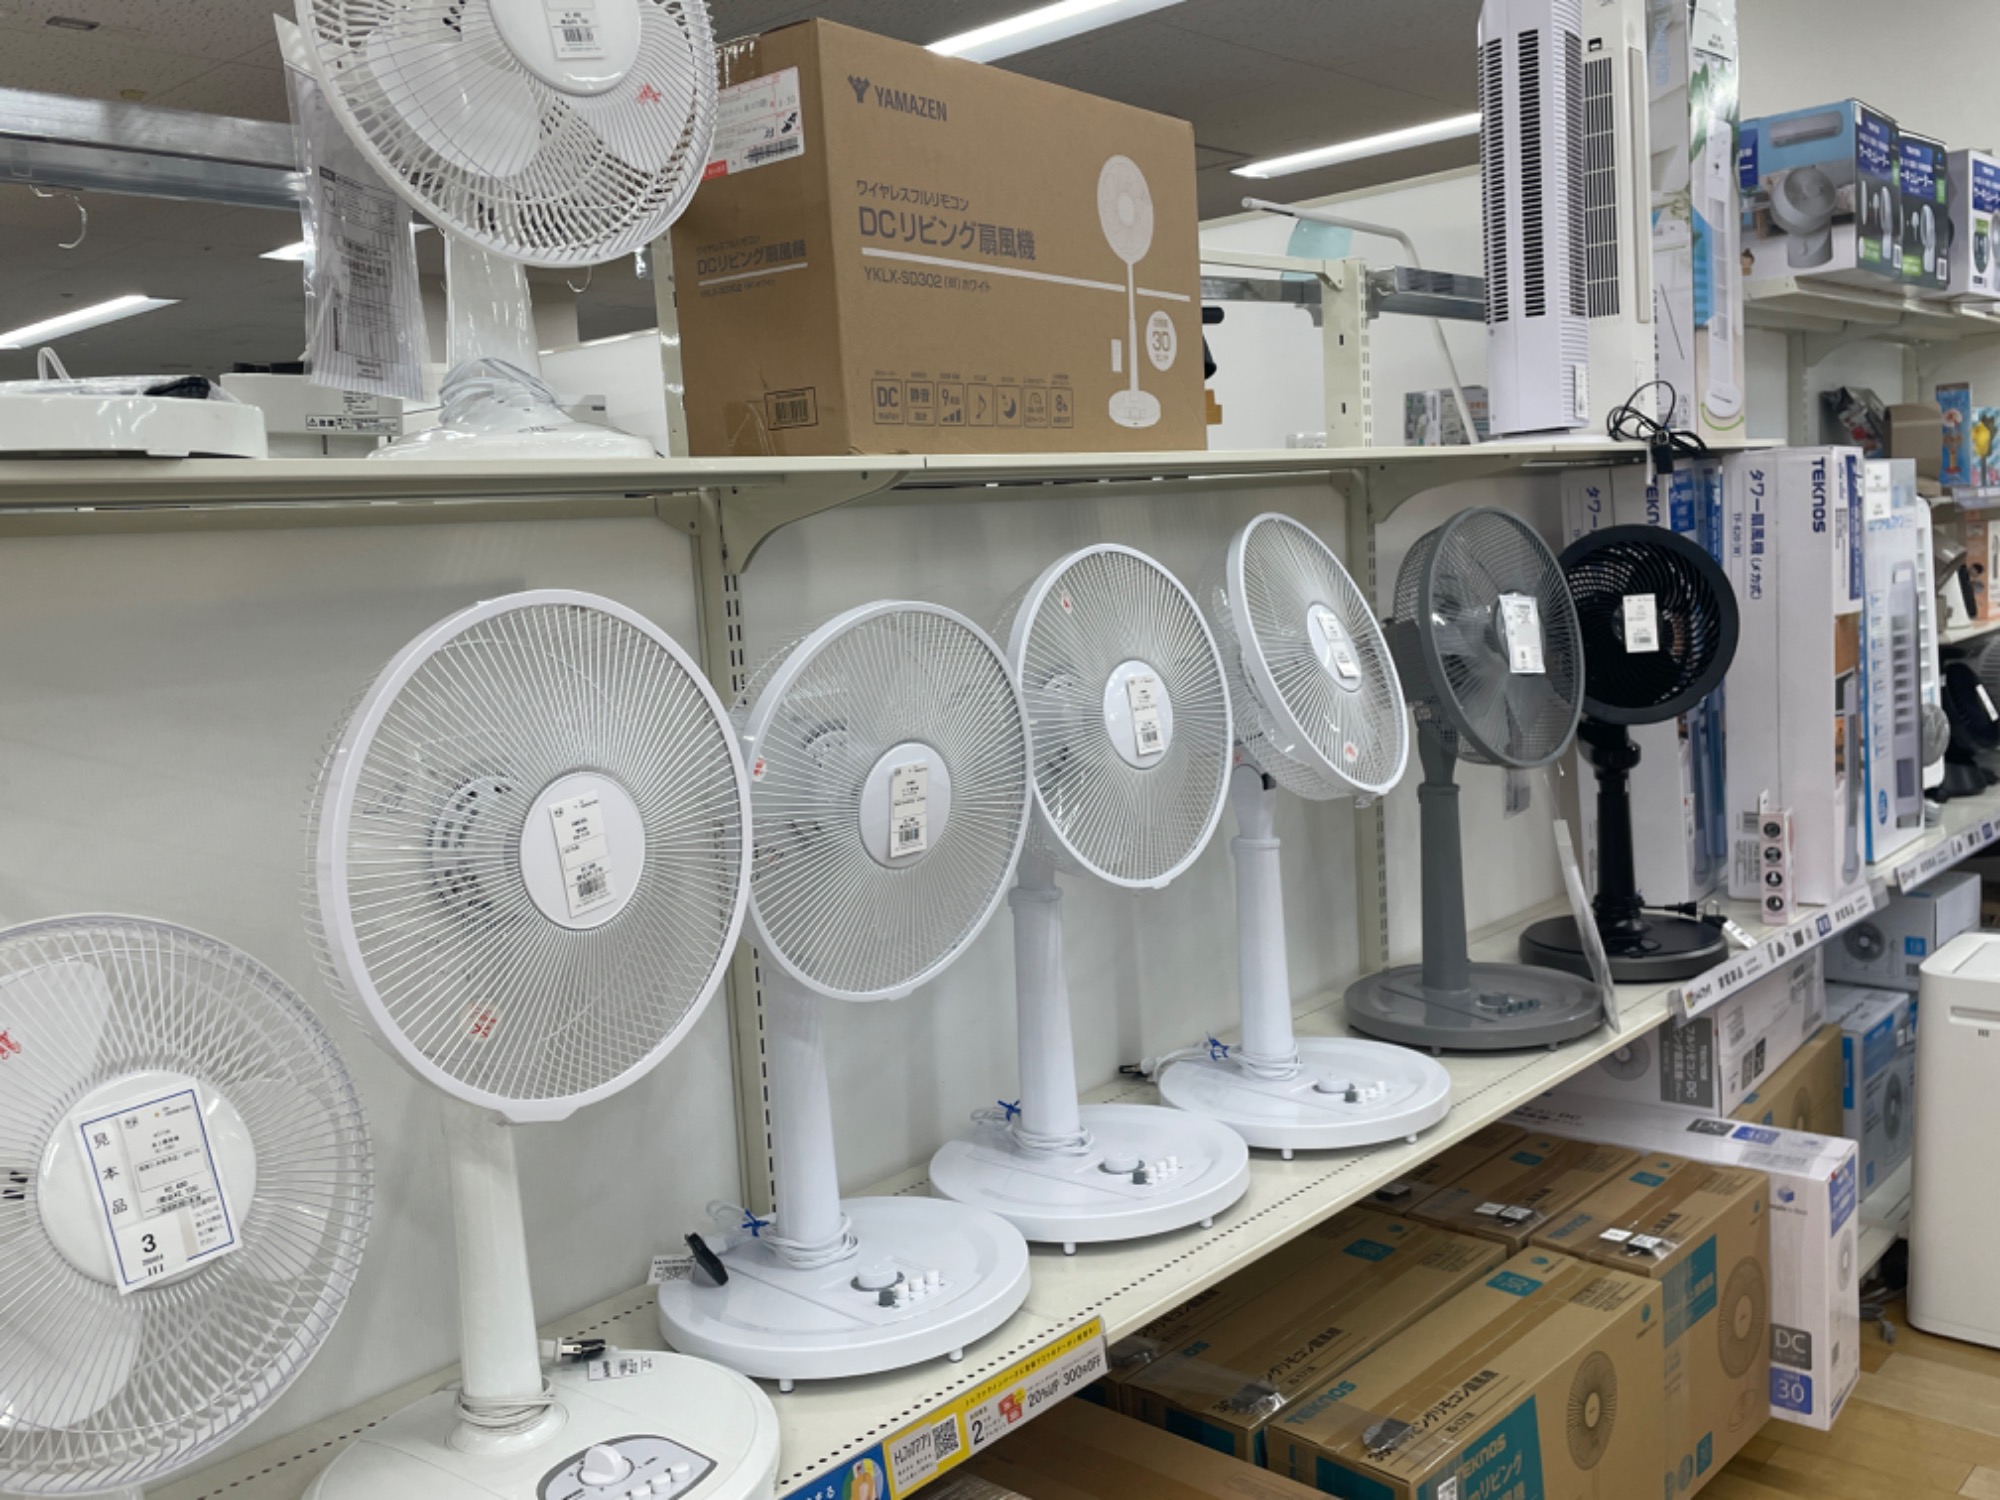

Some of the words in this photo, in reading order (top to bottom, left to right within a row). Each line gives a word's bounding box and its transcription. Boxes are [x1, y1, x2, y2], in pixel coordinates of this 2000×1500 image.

[874, 85, 948, 122] YAMAZEN
[856, 179, 969, 212] ワイヤレスフルリモコン
[858, 205, 1036, 261] DCリビング扇風機
[1152, 330, 1172, 352] 30
[876, 386, 900, 408] DC
[1586, 485, 1601, 533] タワー
[1646, 474, 1660, 526] TEKN
[1811, 456, 1827, 534] TEKNOS
[141, 1234, 158, 1253] 3
[1775, 1328, 1807, 1354] DC
[1284, 1379, 1357, 1426] TEKNOS
[1777, 1378, 1805, 1404] 30
[972, 1420, 985, 1445] 2
[1455, 1433, 1507, 1479] TEKNOS
